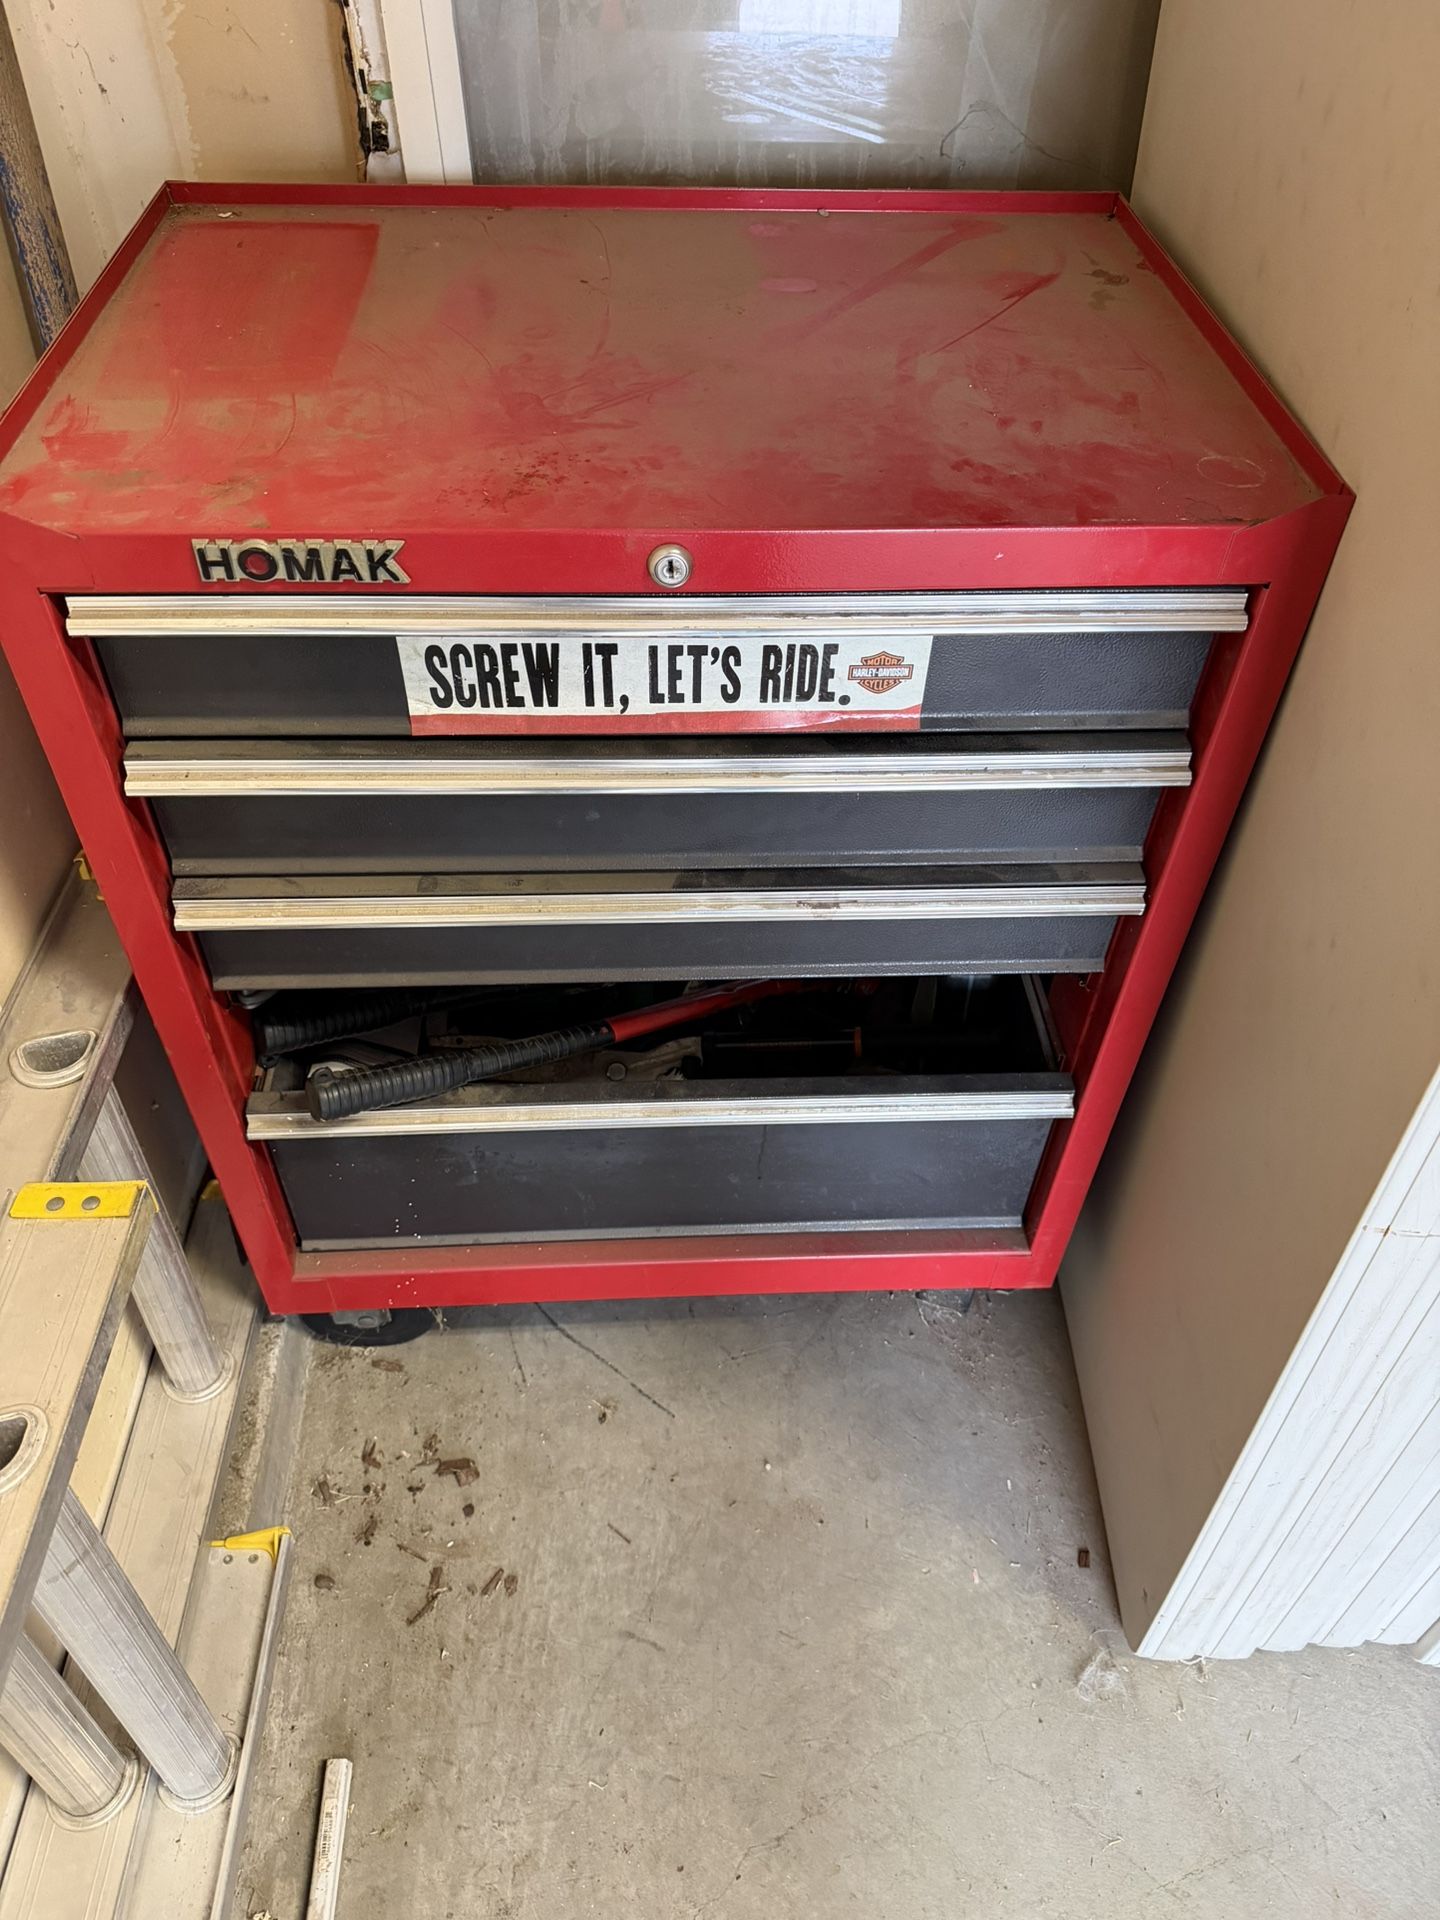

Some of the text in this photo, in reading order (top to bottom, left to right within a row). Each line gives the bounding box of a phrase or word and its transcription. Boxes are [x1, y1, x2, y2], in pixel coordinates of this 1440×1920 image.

[193, 540, 410, 584] HOMAK
[867, 656, 898, 666] MOTOR
[424, 643, 851, 714] SCREW IT, LET'S RIDE.
[852, 667, 910, 678] HARLEY-DAVIDSON
[864, 679, 896, 691] CYCLES
